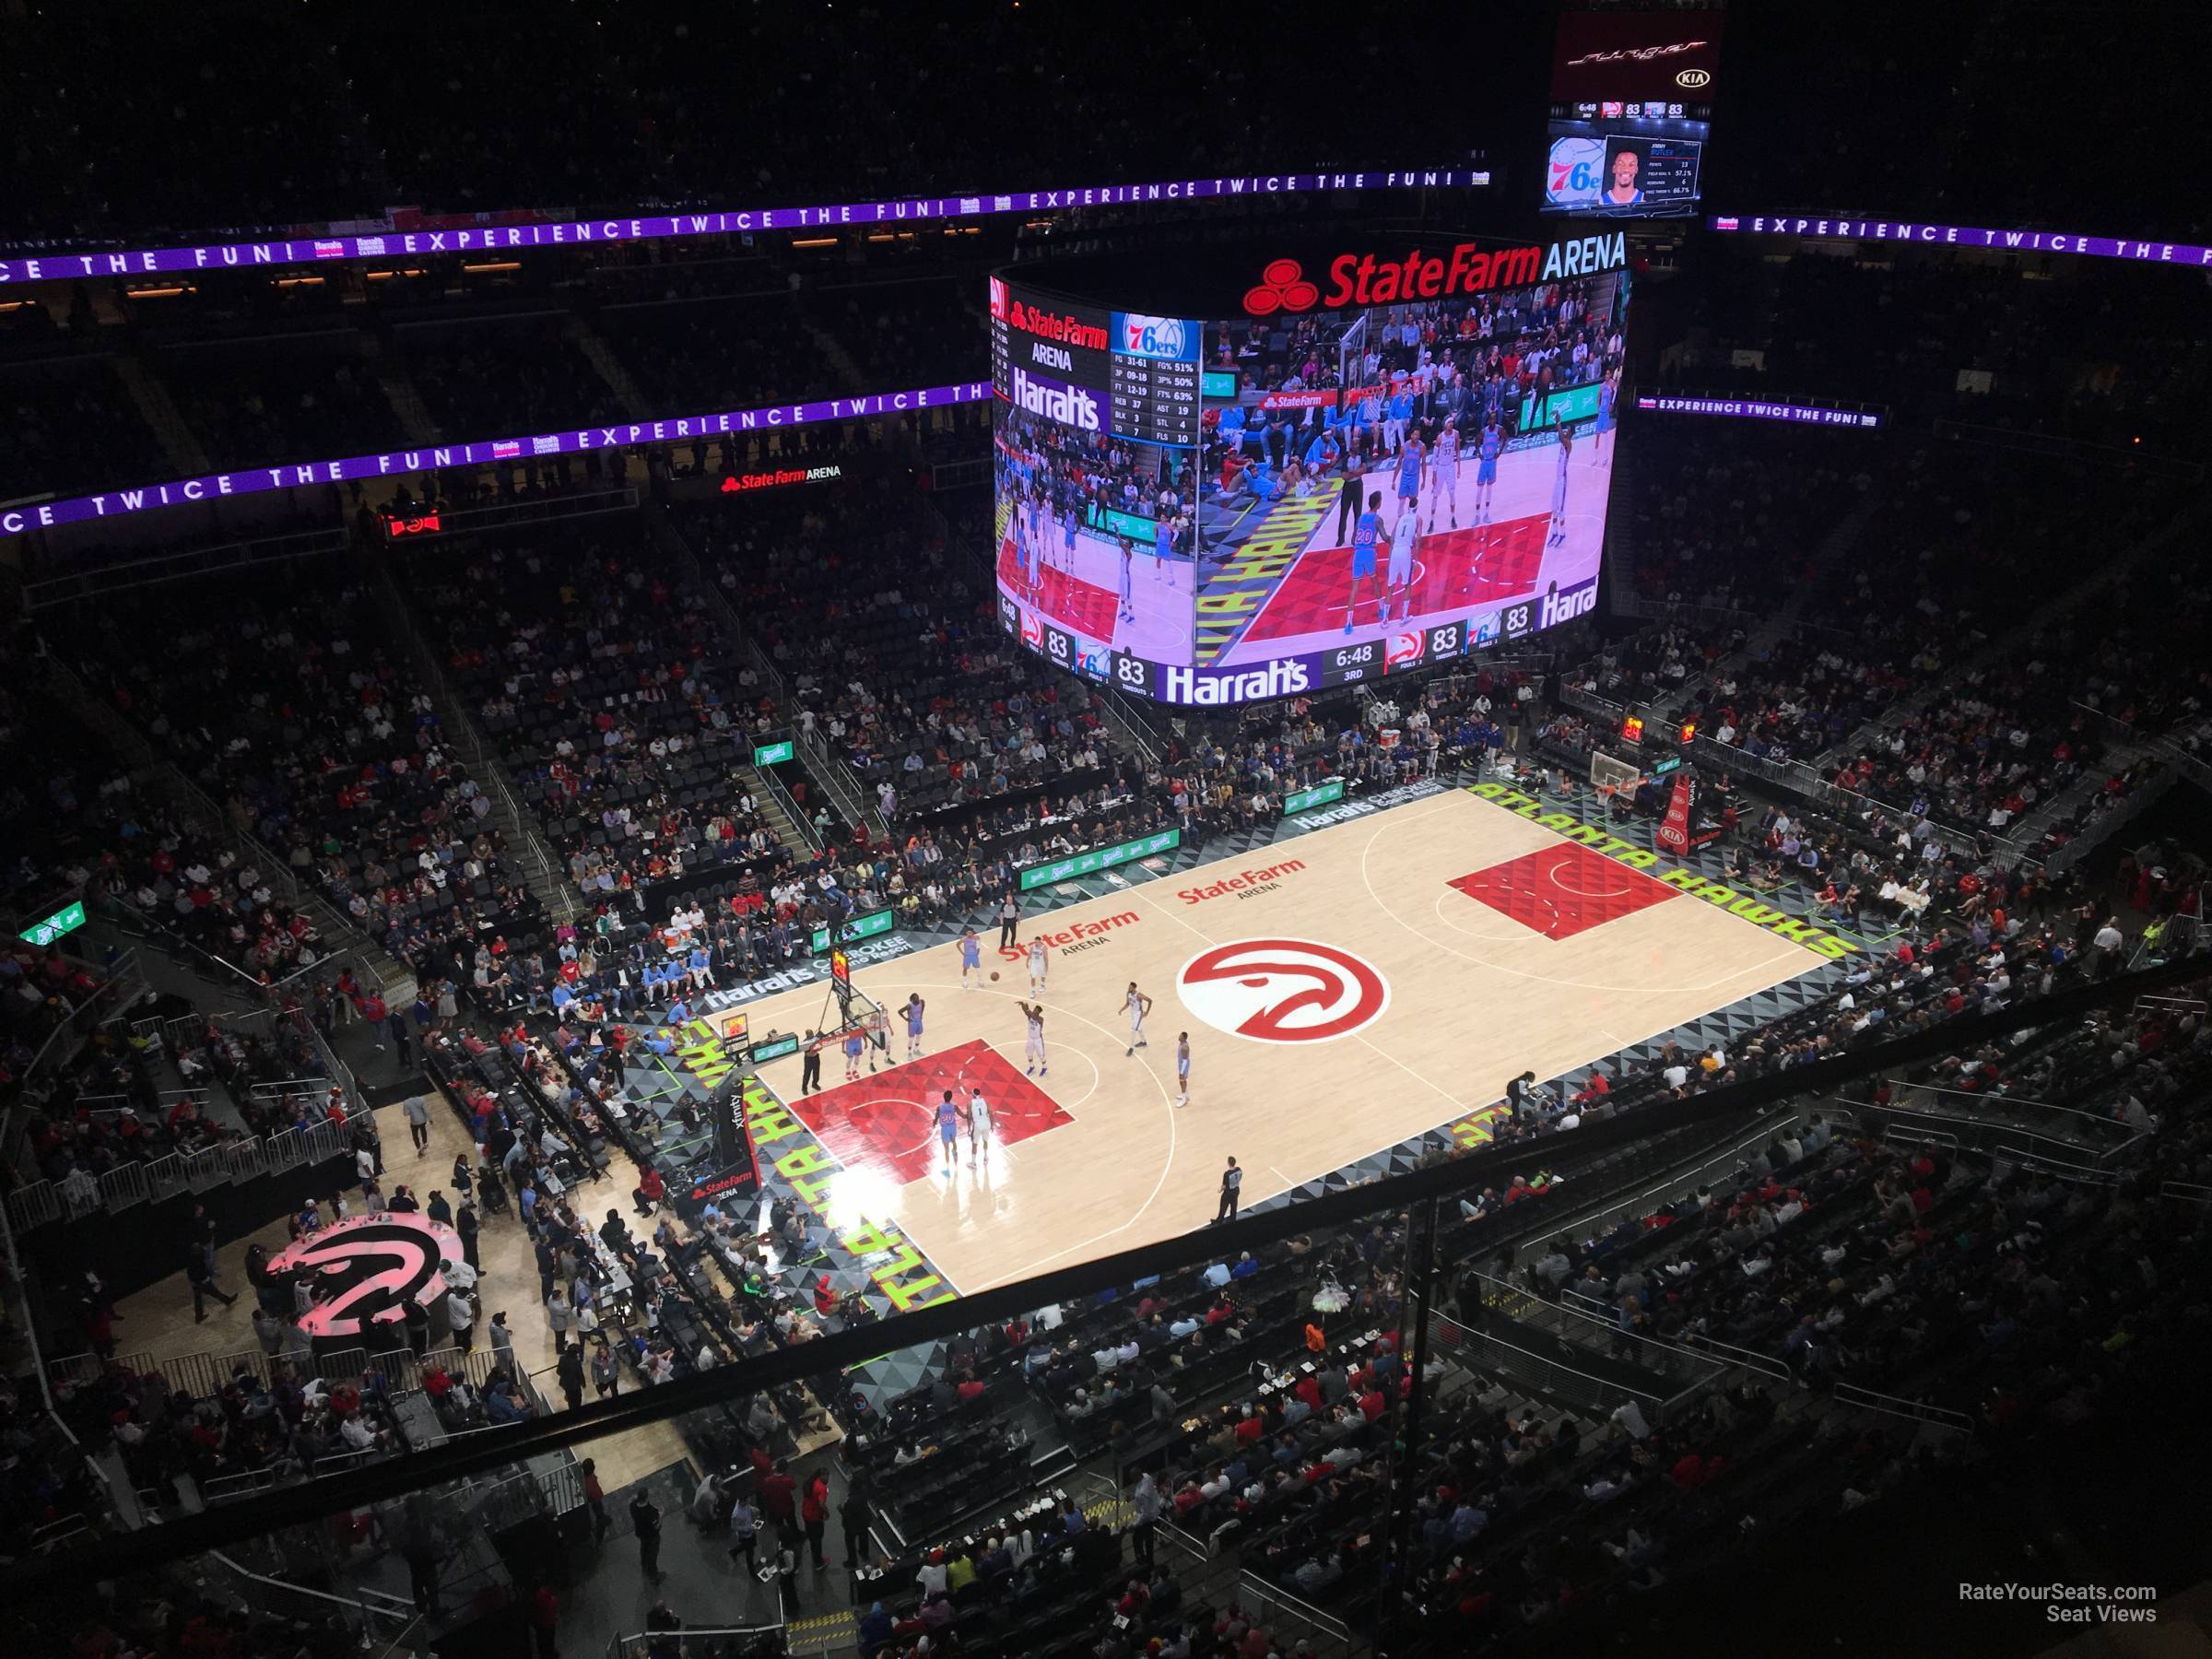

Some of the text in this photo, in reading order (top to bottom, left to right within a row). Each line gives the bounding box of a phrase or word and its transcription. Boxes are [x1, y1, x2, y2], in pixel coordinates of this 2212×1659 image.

[1579, 103, 1597, 112] 6:48
[1626, 103, 1641, 115] 83
[1668, 103, 1683, 115] 83
[1030, 182, 1194, 208] EXPERIENCE
[1215, 176, 1296, 194] TWICE
[1318, 173, 1364, 189] THE
[1387, 171, 1452, 186] FUN!
[404, 220, 641, 253] EXPERIENCE
[670, 211, 772, 234] TWICE
[799, 206, 851, 225] THE
[877, 199, 947, 219] FUN!
[1754, 218, 1958, 242] EXPERIENCE
[1985, 230, 2088, 253] TWICE
[2116, 241, 2173, 260] THE
[79, 252, 158, 275] THE
[194, 242, 293, 267] FUN!
[1542, 230, 1626, 281] ARENA
[1129, 324, 1179, 355] 76ers
[1031, 341, 1074, 372] ARENA
[1114, 354, 1147, 369] FG 31-61
[1157, 360, 1194, 373] FG% 51%
[1114, 369, 1148, 382] 3P 09-18
[1157, 375, 1194, 387] 3P% 50%
[1114, 382, 1147, 396] FT 12-19
[1157, 389, 1194, 402] FT% 63%
[1114, 396, 1142, 409] REB 37
[1156, 404, 1189, 416] AST 19
[578, 383, 982, 449] EXPERIENCE TWICE TH
[1134, 413, 1140, 423] 3
[1658, 399, 1742, 414] EXPERIENCE
[1747, 404, 1790, 418] TWICE
[1794, 408, 1820, 420] THE
[1825, 411, 1858, 425] FUN!
[1156, 418, 1186, 429] STL 4
[1134, 427, 1139, 437] 7
[1156, 431, 1189, 443] FLS 10
[91, 476, 232, 515] TWICE
[268, 462, 342, 487] THE
[378, 445, 472, 473] FUN!
[806, 465, 841, 480] ARENA
[1355, 529, 1371, 544] 20
[1401, 524, 1406, 537] 1
[1001, 596, 1017, 621] 6:48
[1506, 606, 1528, 631] 83
[1048, 630, 1068, 658] 83
[1432, 626, 1458, 653] 83
[1335, 644, 1373, 667] 6:48
[1117, 657, 1146, 685] 83
[1400, 661, 1416, 670] FOULS
[1343, 668, 1363, 681] 3RD
[1122, 683, 1147, 696] TIMEOUTS
[1625, 726, 1640, 739] 24
[1467, 781, 1660, 870] ATLANTA
[1663, 828, 1681, 842] KIA
[1237, 882, 1282, 900] ARENA
[1660, 866, 1860, 959] HAWKS
[1061, 936, 1112, 957] ARENA
[730, 1094, 746, 1129] xfinity
[716, 1188, 738, 1201] RENA
